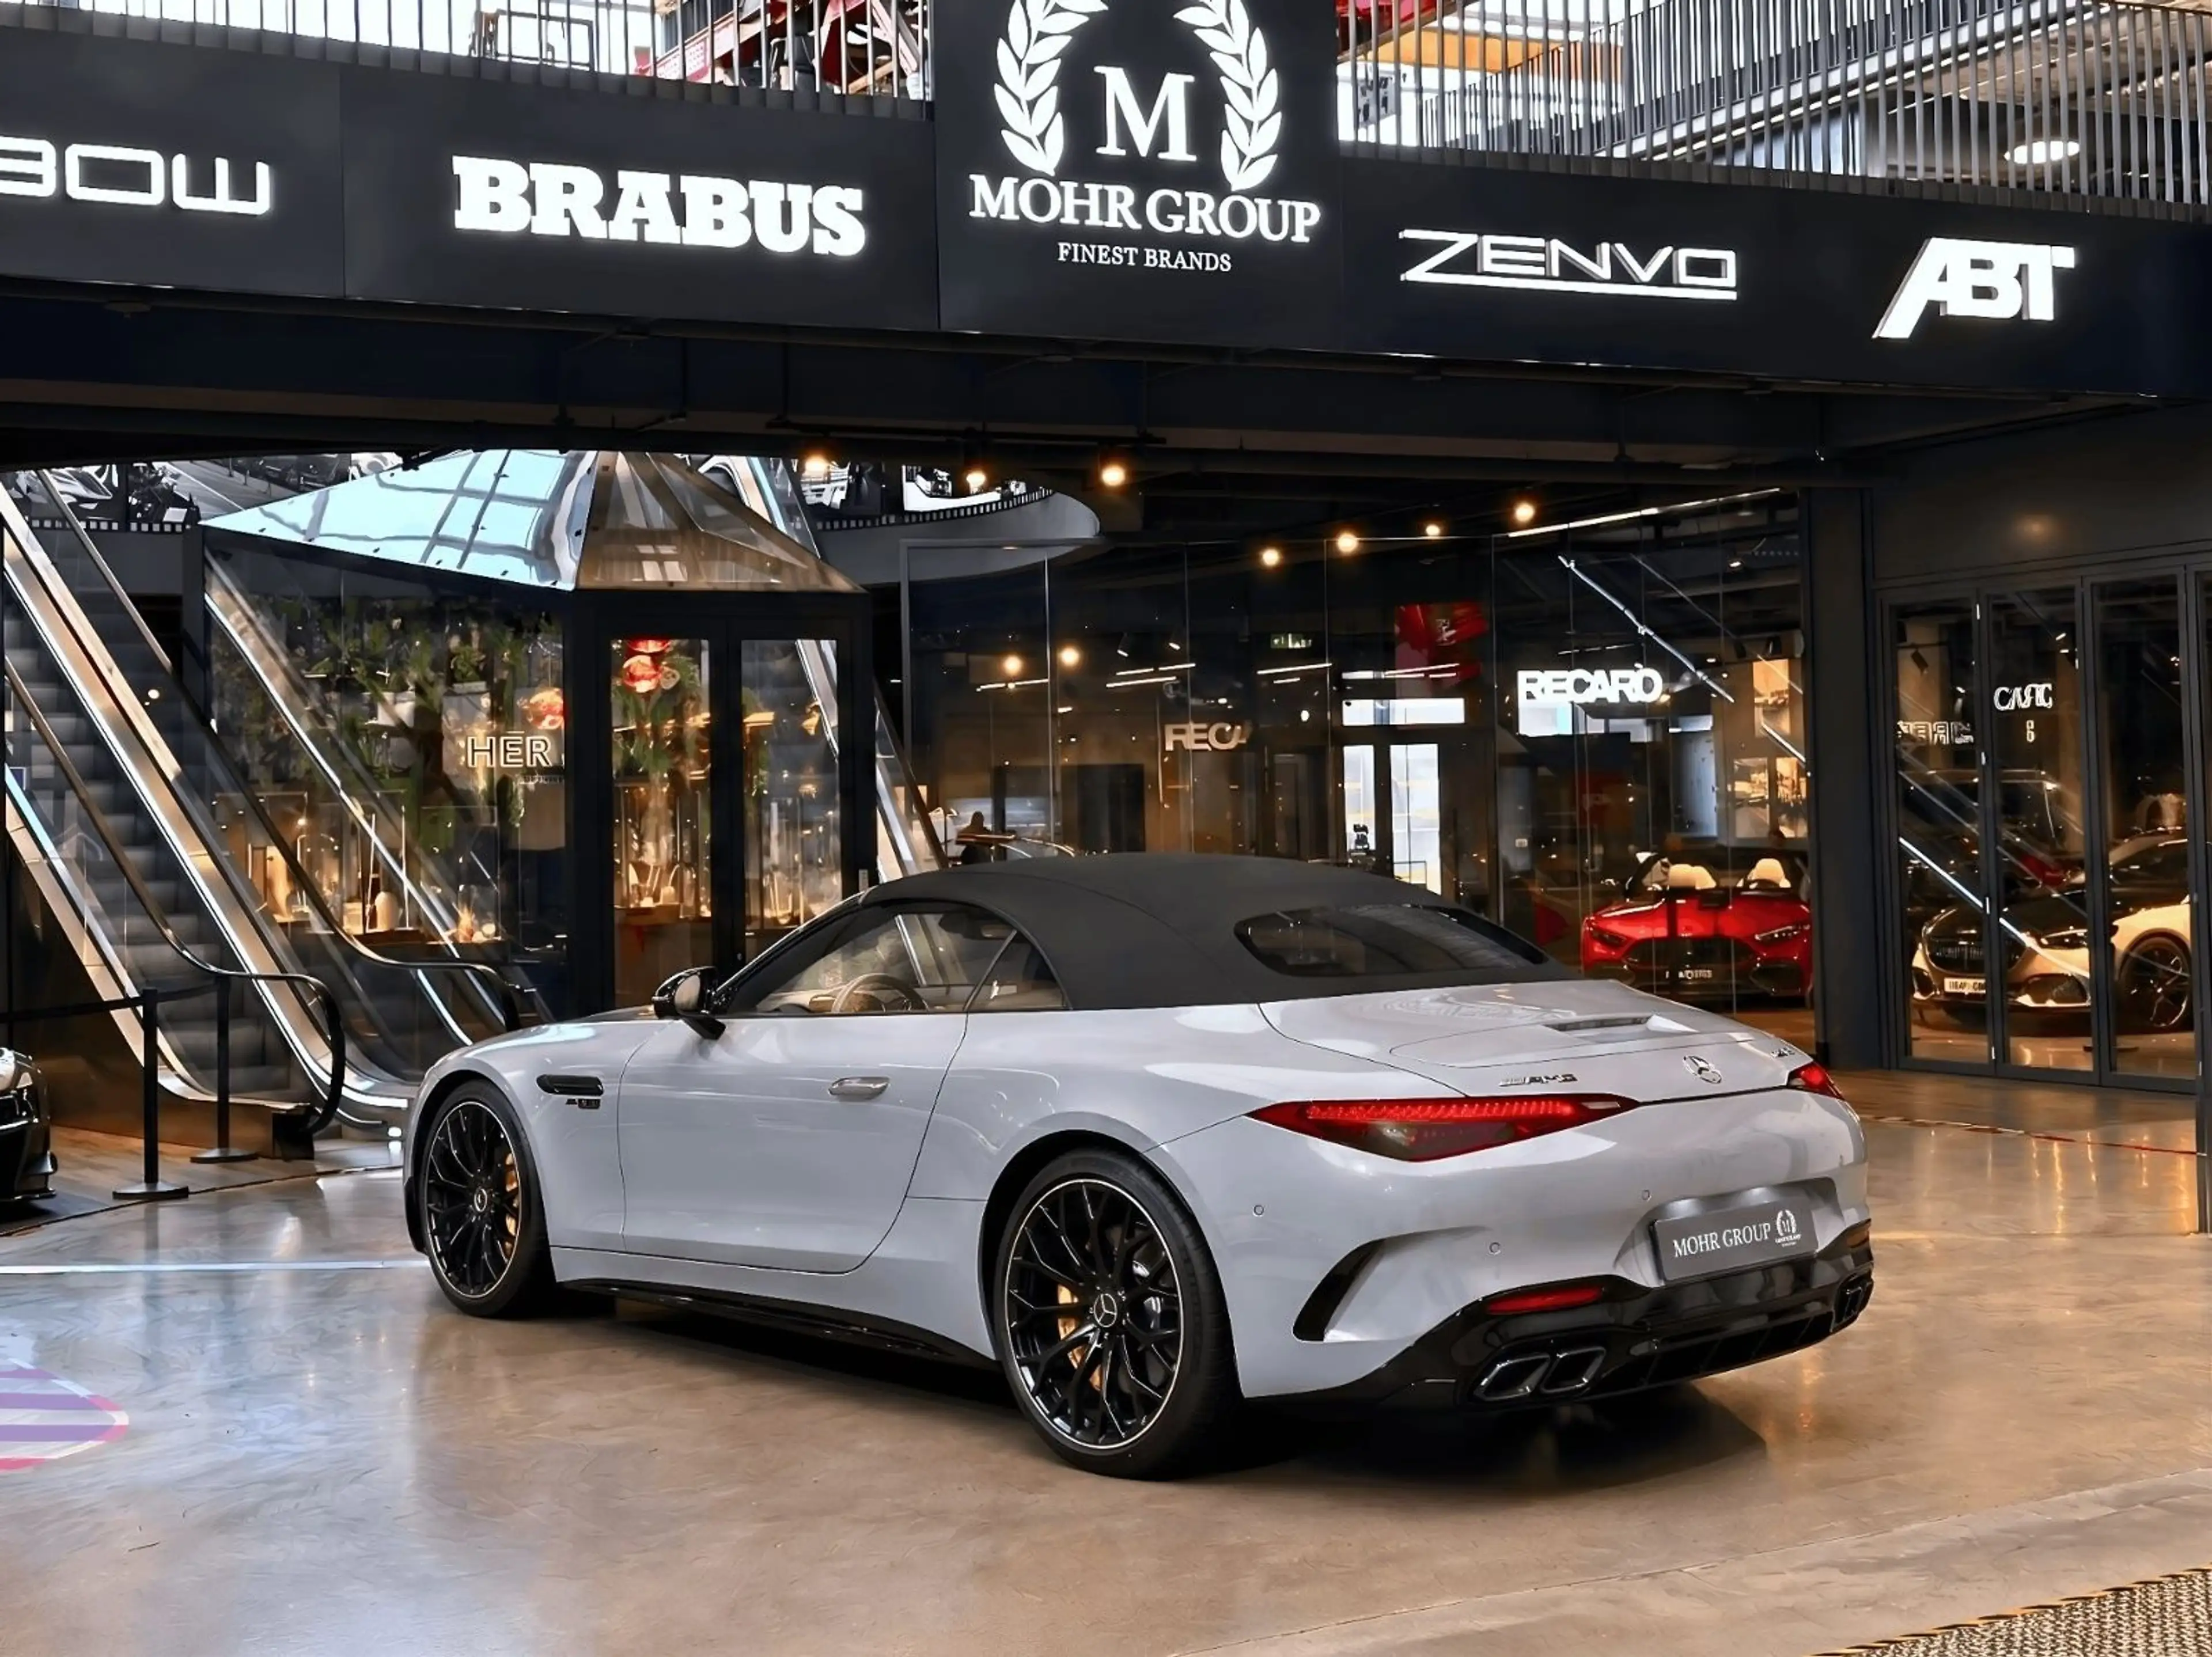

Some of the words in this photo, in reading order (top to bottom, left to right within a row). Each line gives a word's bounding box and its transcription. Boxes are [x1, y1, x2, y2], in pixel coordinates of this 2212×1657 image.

[1093, 65, 1198, 162] M
[452, 155, 866, 257] BRABUS
[969, 173, 1142, 230] MOHR
[1145, 188, 1321, 244] GROUP
[1058, 242, 1139, 266] FINEST
[1143, 248, 1232, 272] BRANDS
[1399, 229, 1738, 300] ZENVO
[1872, 237, 2075, 339] ABT
[1517, 668, 1662, 703] RECARO
[1672, 1231, 1721, 1258] MOHR
[1722, 1223, 1771, 1248] GROUP
